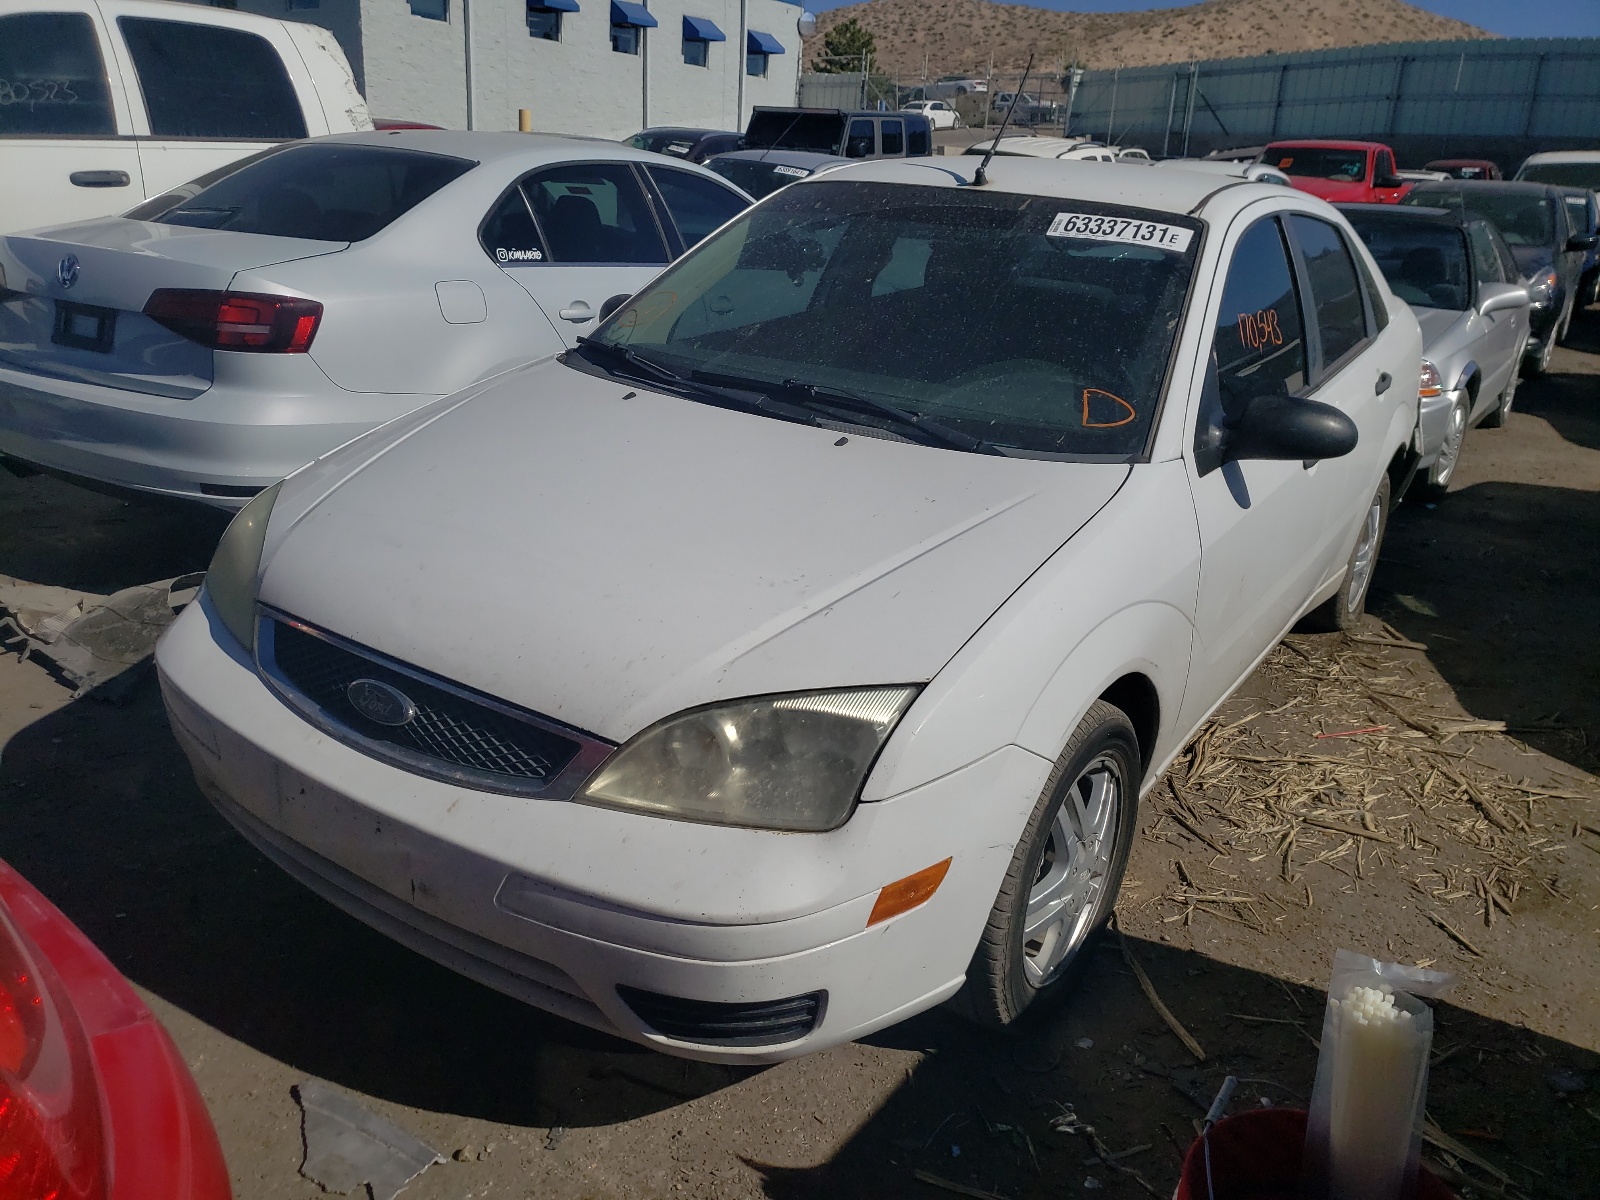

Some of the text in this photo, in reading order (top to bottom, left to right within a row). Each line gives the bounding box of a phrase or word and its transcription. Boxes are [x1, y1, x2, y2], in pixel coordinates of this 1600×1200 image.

[1063, 215, 1169, 243] 63337131
[1168, 234, 1180, 244] E
[1237, 309, 1283, 355] 170,543
[1082, 388, 1136, 427] D
